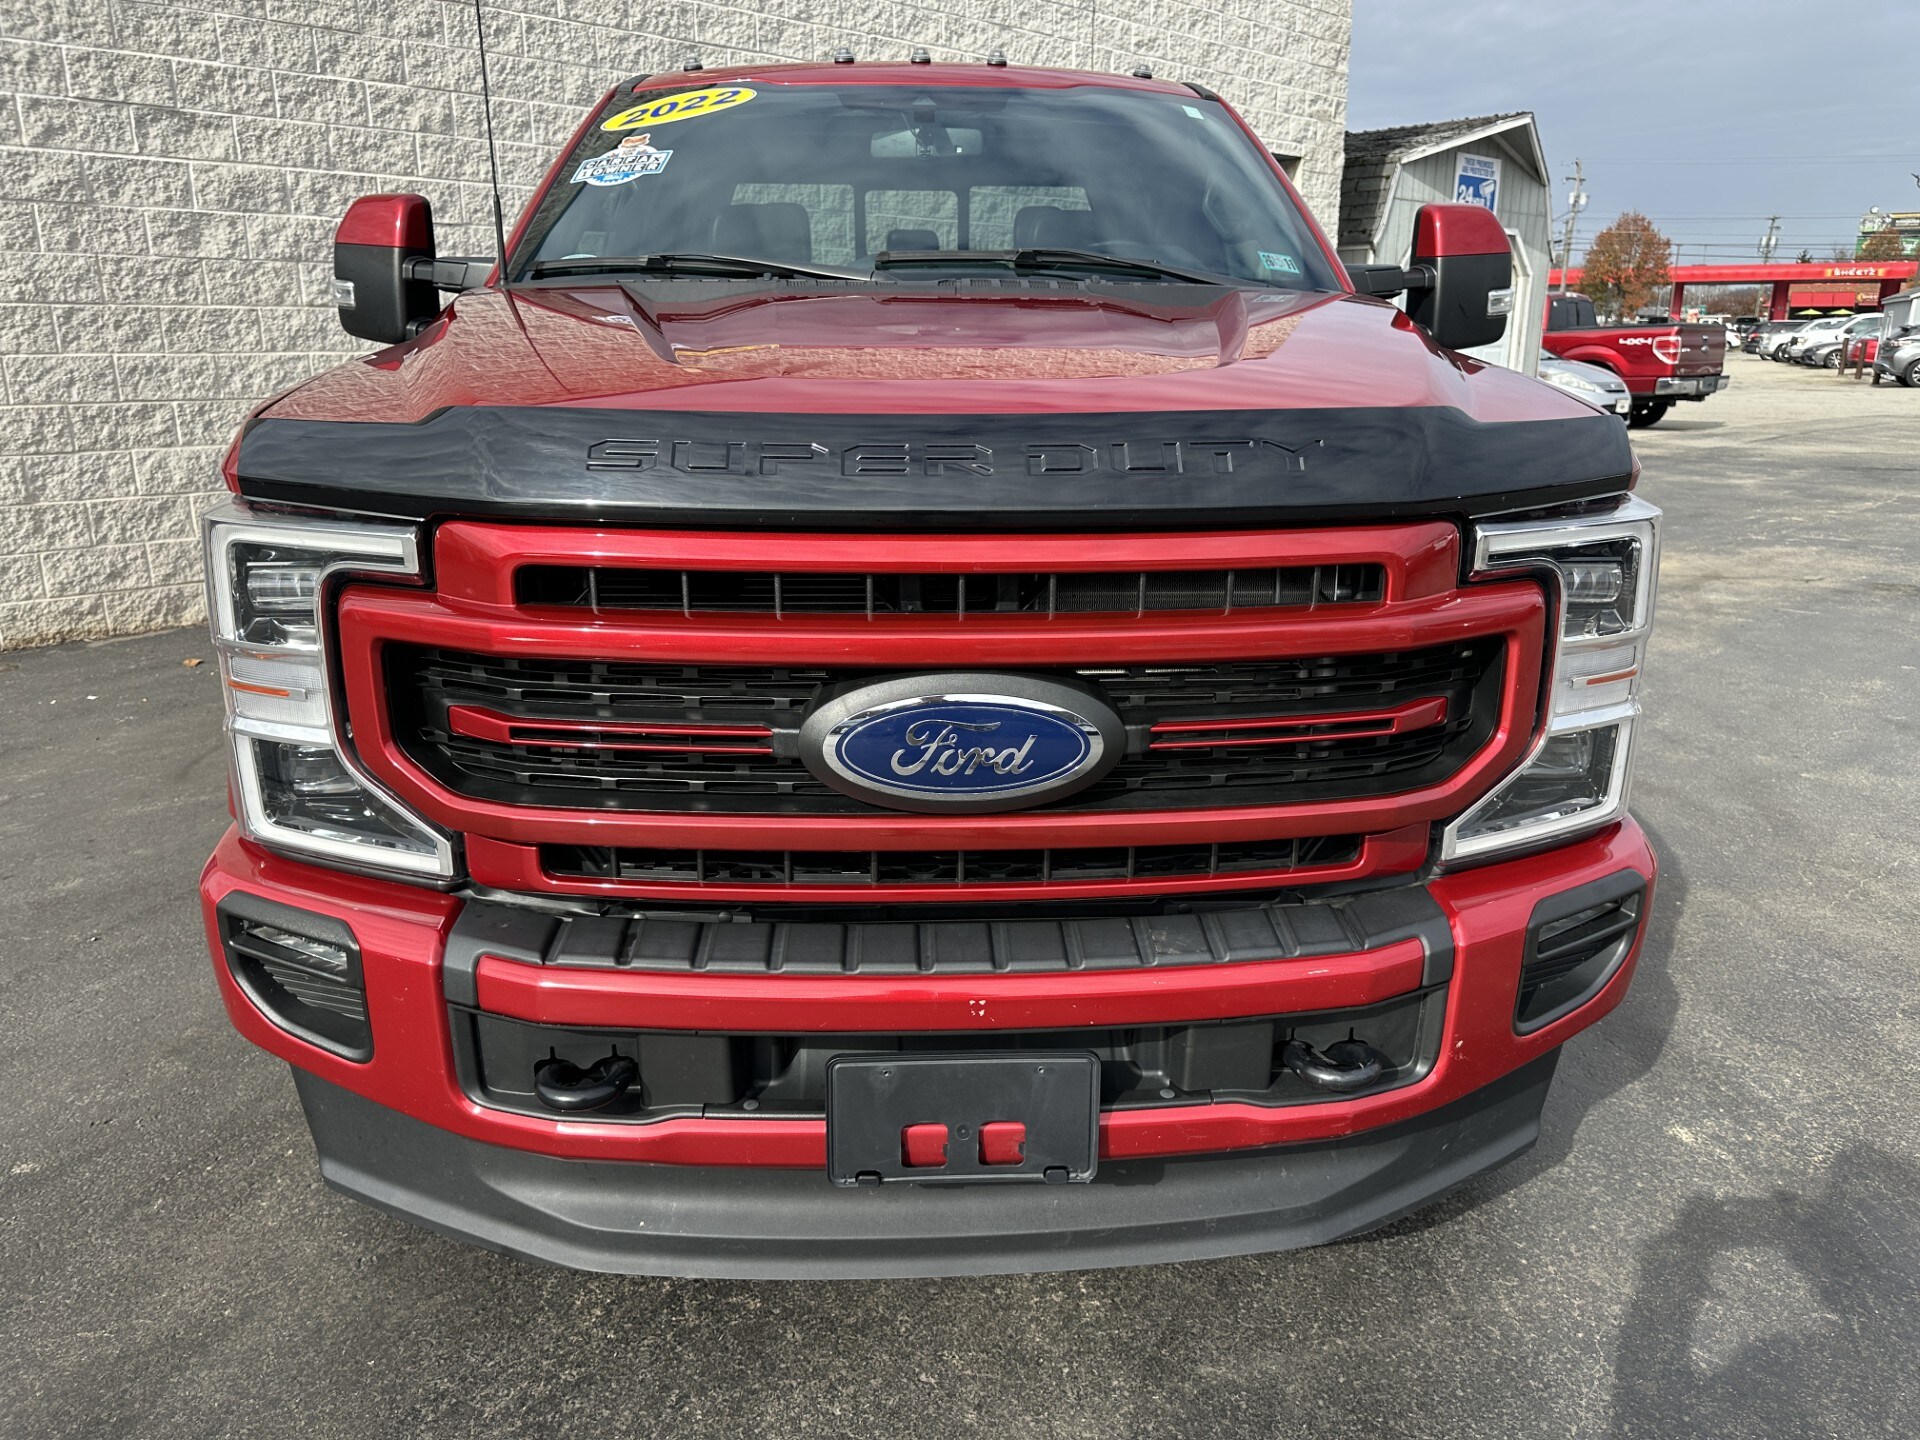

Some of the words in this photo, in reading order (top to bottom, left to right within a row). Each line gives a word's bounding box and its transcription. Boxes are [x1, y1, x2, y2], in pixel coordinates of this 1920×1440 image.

[618, 90, 741, 127] 2022
[586, 155, 662, 169] CARFAX
[592, 163, 659, 176] OWNER
[1458, 184, 1474, 204] 24
[586, 437, 994, 476] SUPER
[1025, 437, 1325, 476] DUTY
[890, 719, 1038, 776] Ford
